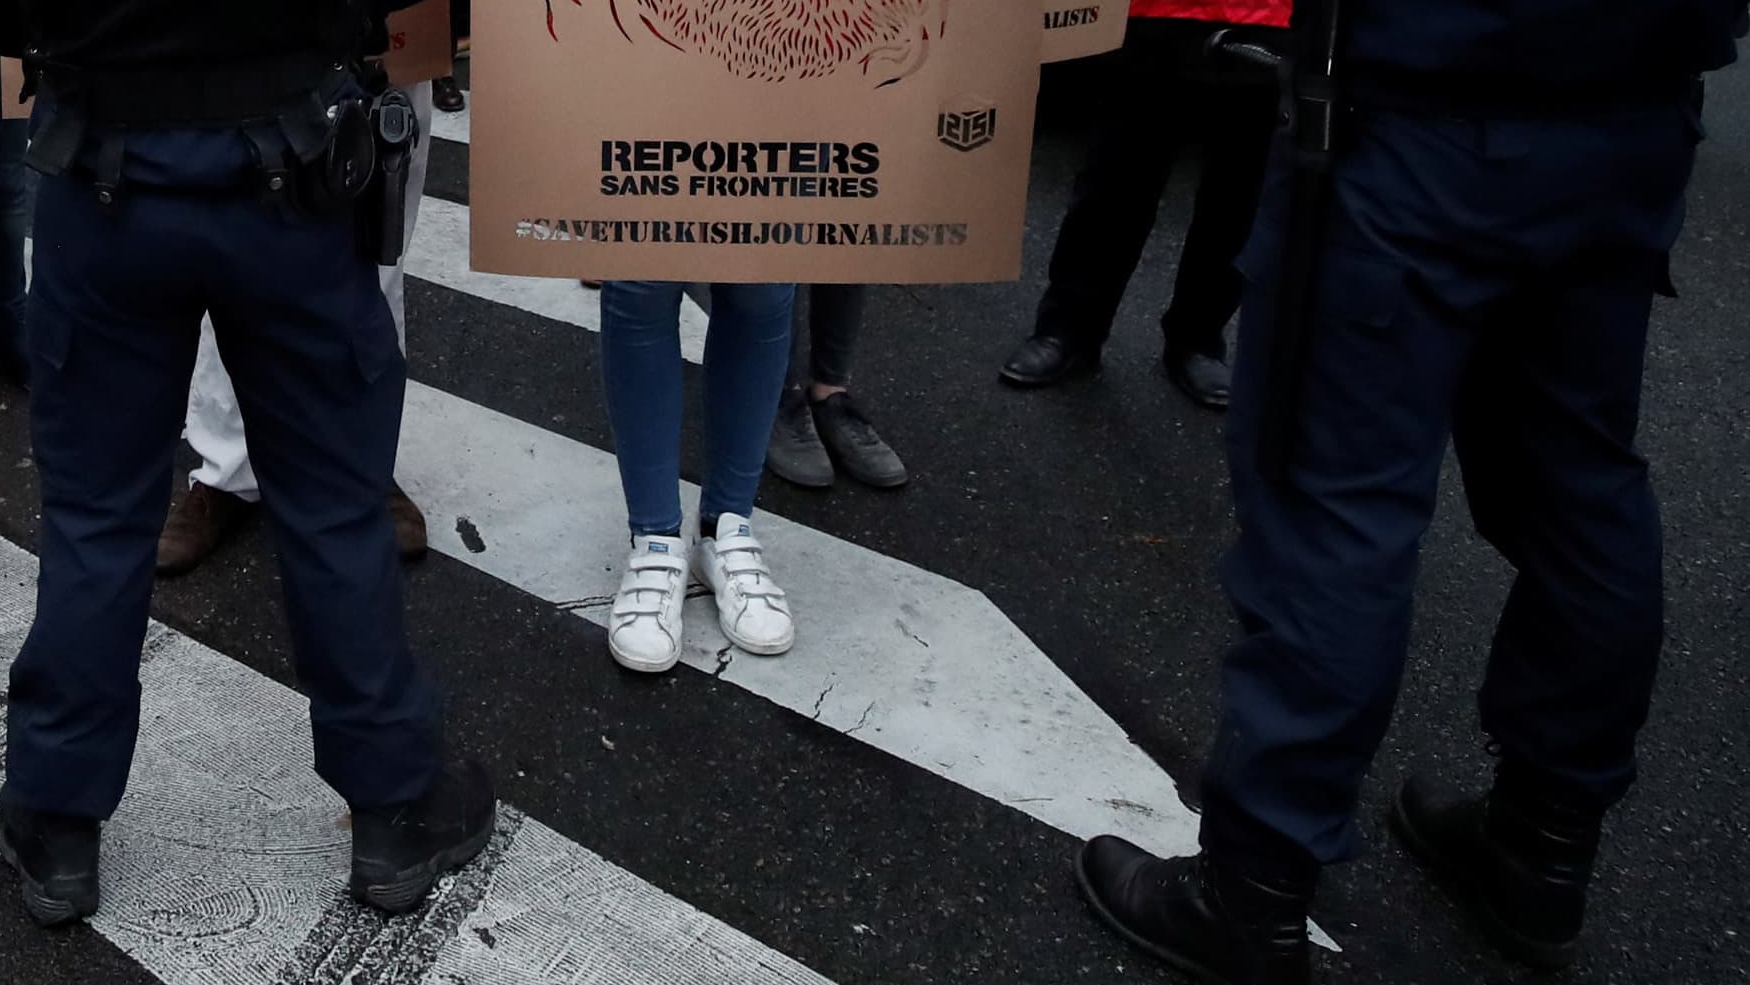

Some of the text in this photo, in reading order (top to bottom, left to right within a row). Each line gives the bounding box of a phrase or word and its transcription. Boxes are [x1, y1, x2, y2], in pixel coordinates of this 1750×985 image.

[601, 140, 880, 174] REPORTERS
[600, 175, 879, 198] SANS FRONTIERES
[515, 217, 968, 246] #SAVETURKISHJOURNALISTS
